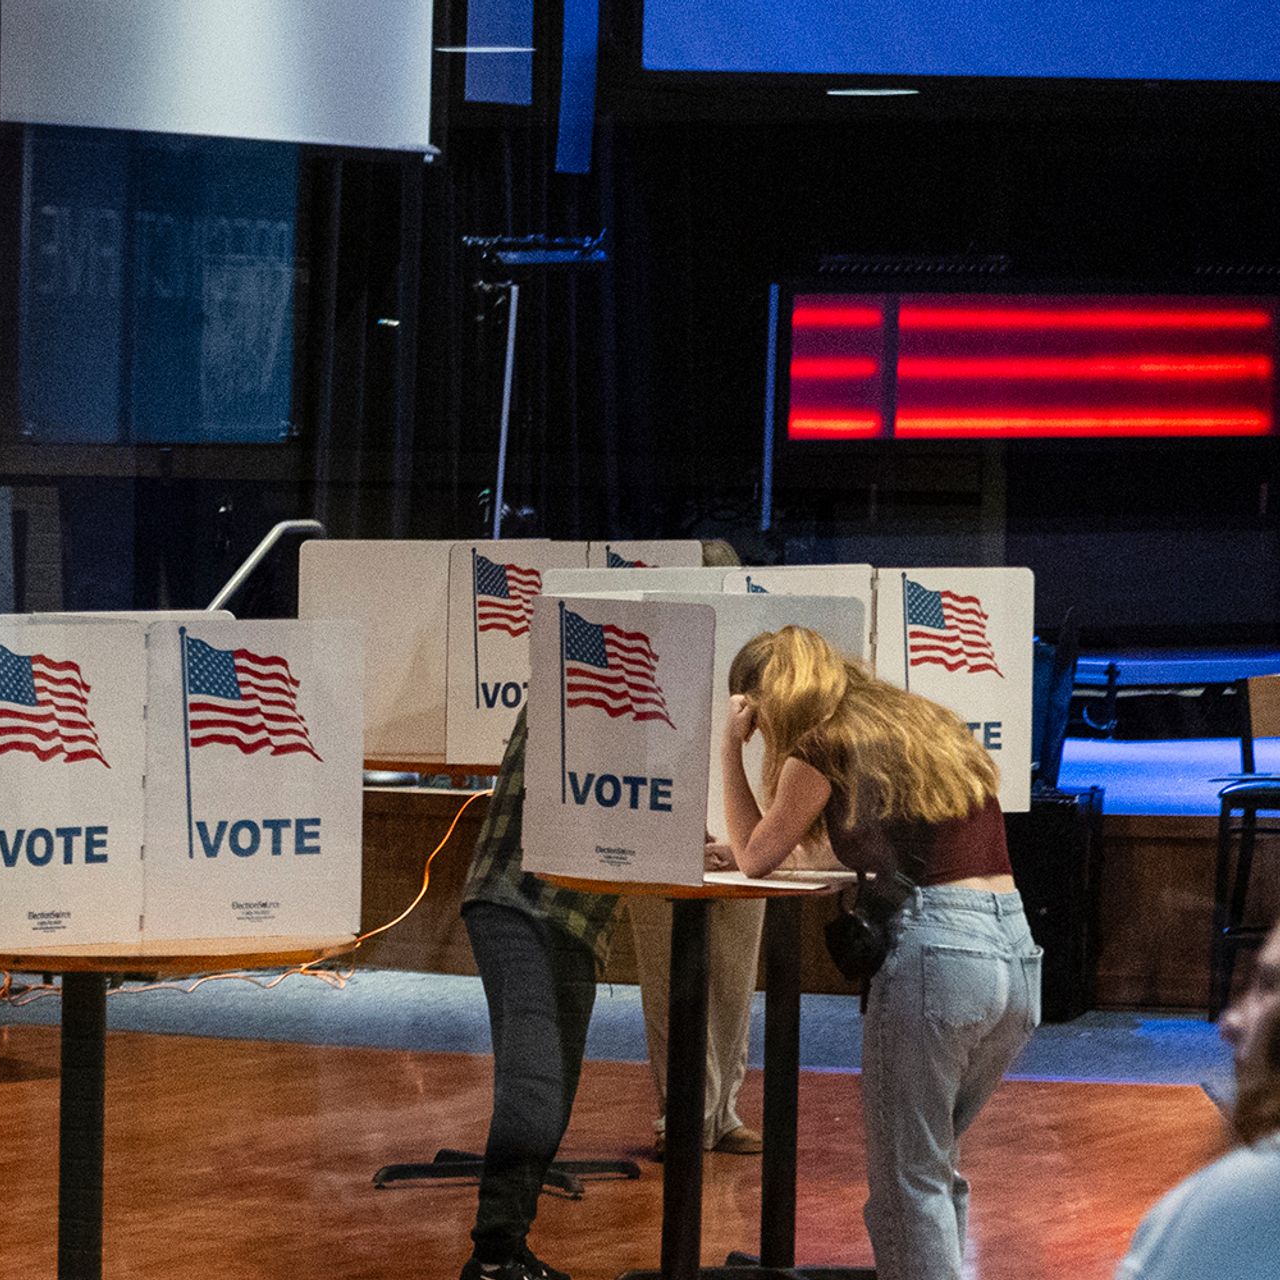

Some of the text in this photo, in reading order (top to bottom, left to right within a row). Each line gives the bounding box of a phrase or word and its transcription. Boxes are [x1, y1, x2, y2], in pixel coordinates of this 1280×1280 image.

[481, 681, 528, 709] VO
[568, 771, 673, 812] VOTE
[195, 818, 321, 858] VOTE
